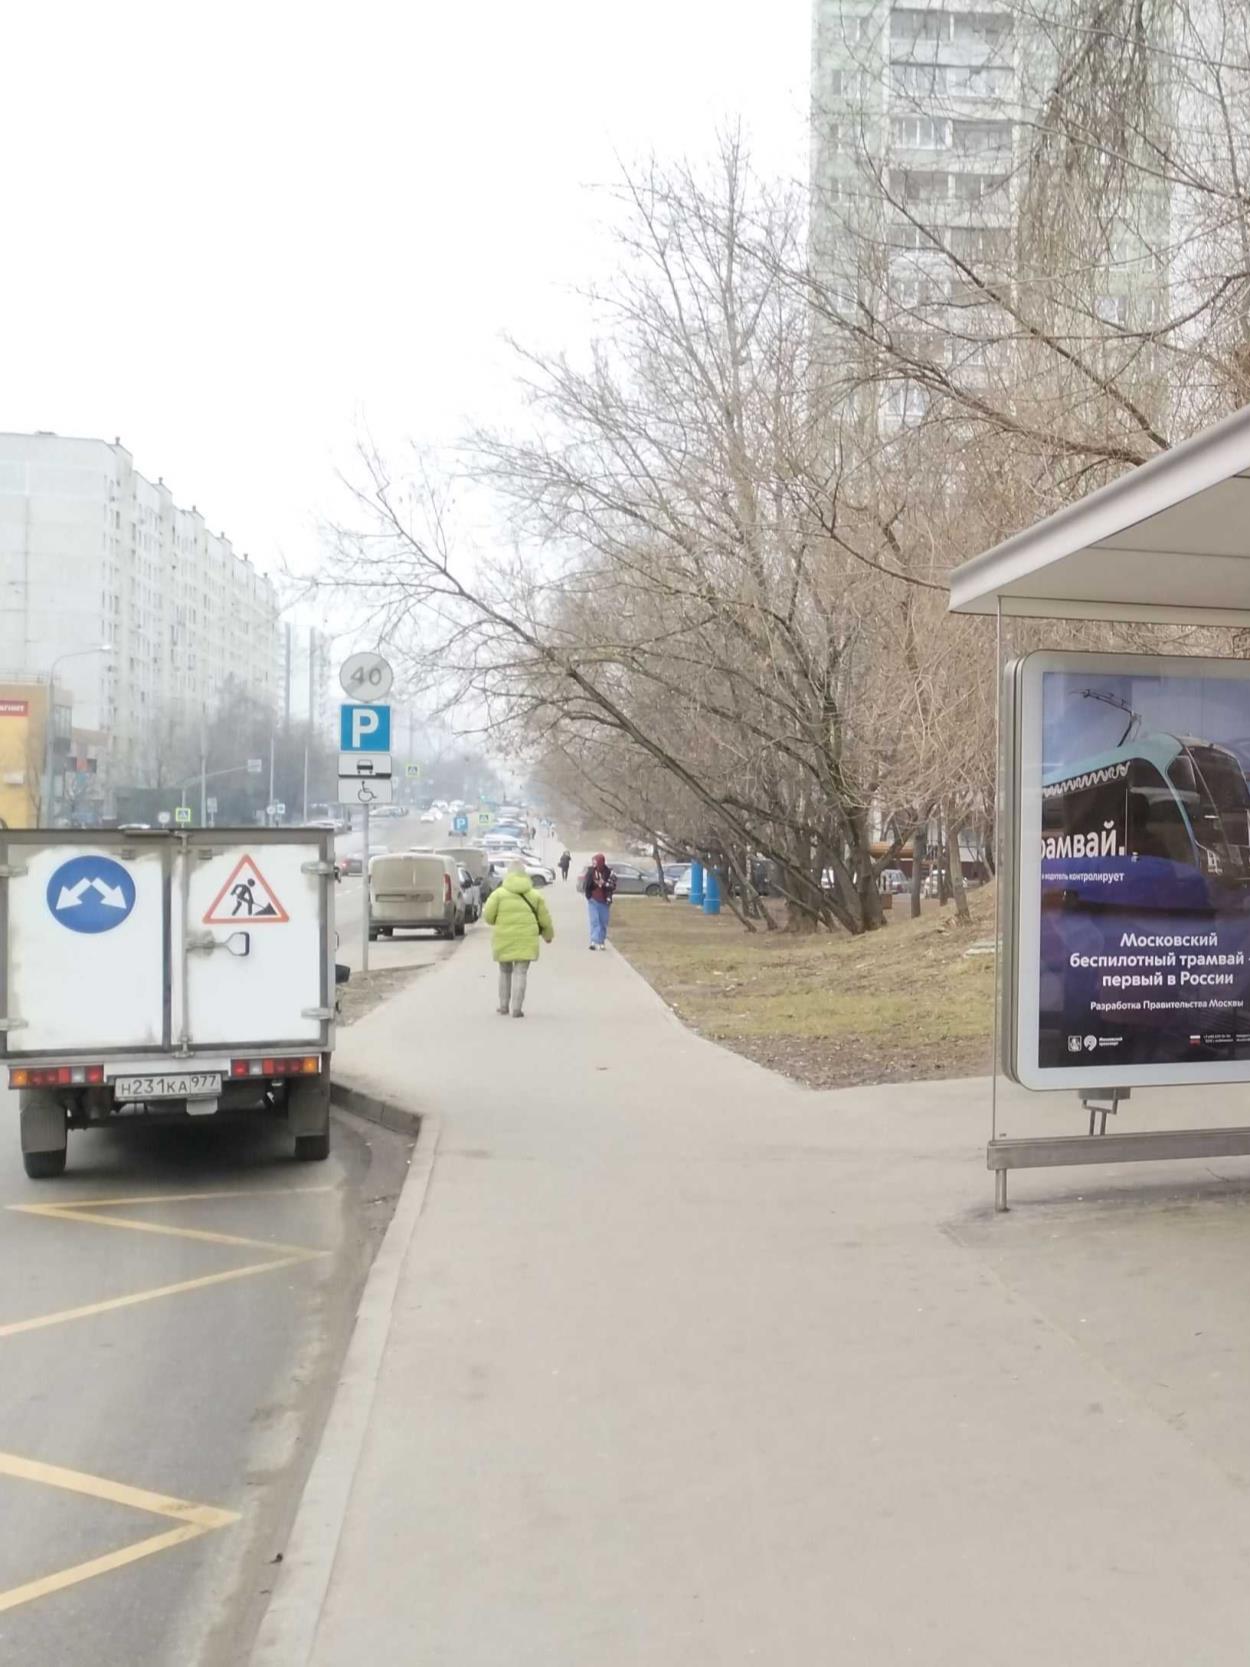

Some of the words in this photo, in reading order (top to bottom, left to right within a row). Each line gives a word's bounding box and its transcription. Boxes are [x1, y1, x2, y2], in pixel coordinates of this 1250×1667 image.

[350, 666, 382, 687] 40
[352, 708, 379, 748] P
[1069, 871, 1125, 884] контролирует
[1120, 932, 1218, 947] Московский
[1070, 952, 1176, 967] беспилотный
[1179, 951, 1245, 969] трамвай
[1102, 972, 1163, 989] первый
[1167, 974, 1176, 986] в
[1180, 972, 1233, 986] России
[1090, 1001, 1141, 1012] Разработка
[1143, 1000, 1207, 1011] Правительства
[1209, 998, 1244, 1008] Москвы
[191, 1075, 217, 1088] 977
